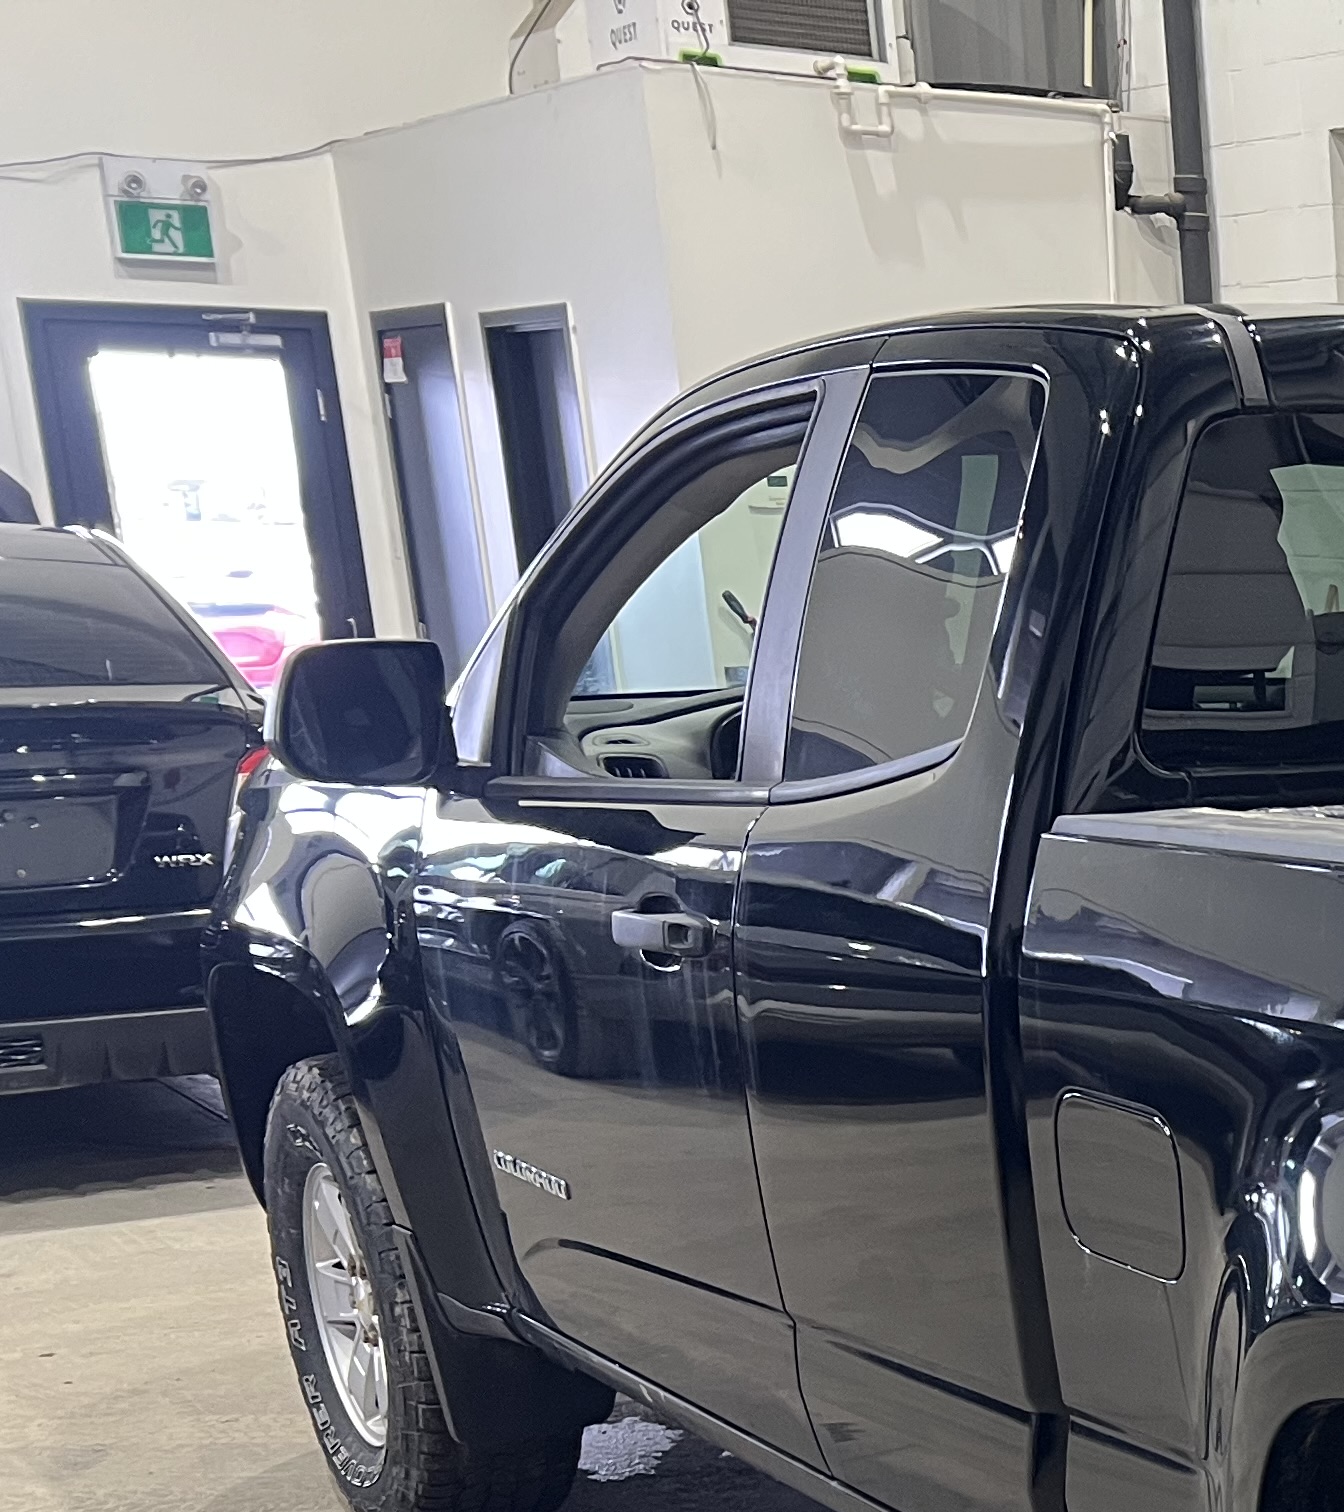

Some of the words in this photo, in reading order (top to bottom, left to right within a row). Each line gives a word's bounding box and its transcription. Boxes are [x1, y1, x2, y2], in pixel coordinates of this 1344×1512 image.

[610, 22, 638, 50] QUEST
[671, 19, 714, 34] QUEST
[153, 853, 214, 868] WRX
[494, 1149, 569, 1200] COLORADO
